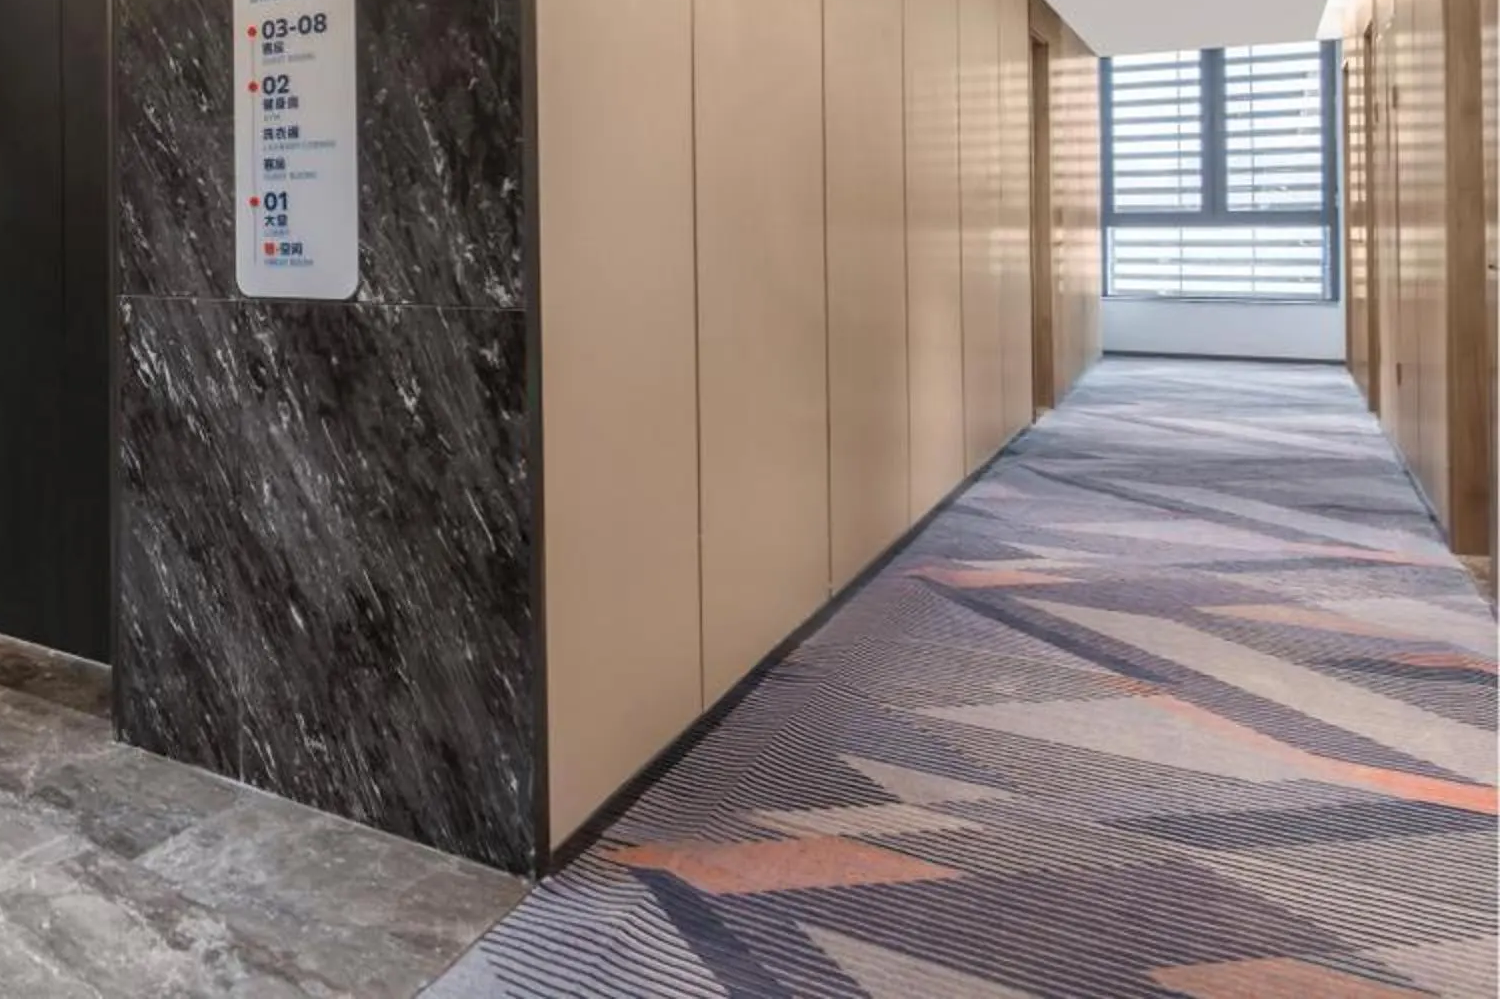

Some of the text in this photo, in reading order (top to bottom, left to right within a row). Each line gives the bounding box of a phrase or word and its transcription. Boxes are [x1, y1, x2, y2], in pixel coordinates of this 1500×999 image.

[262, 13, 327, 39] 03-08
[263, 75, 289, 94] 02
[264, 191, 288, 210] 01
